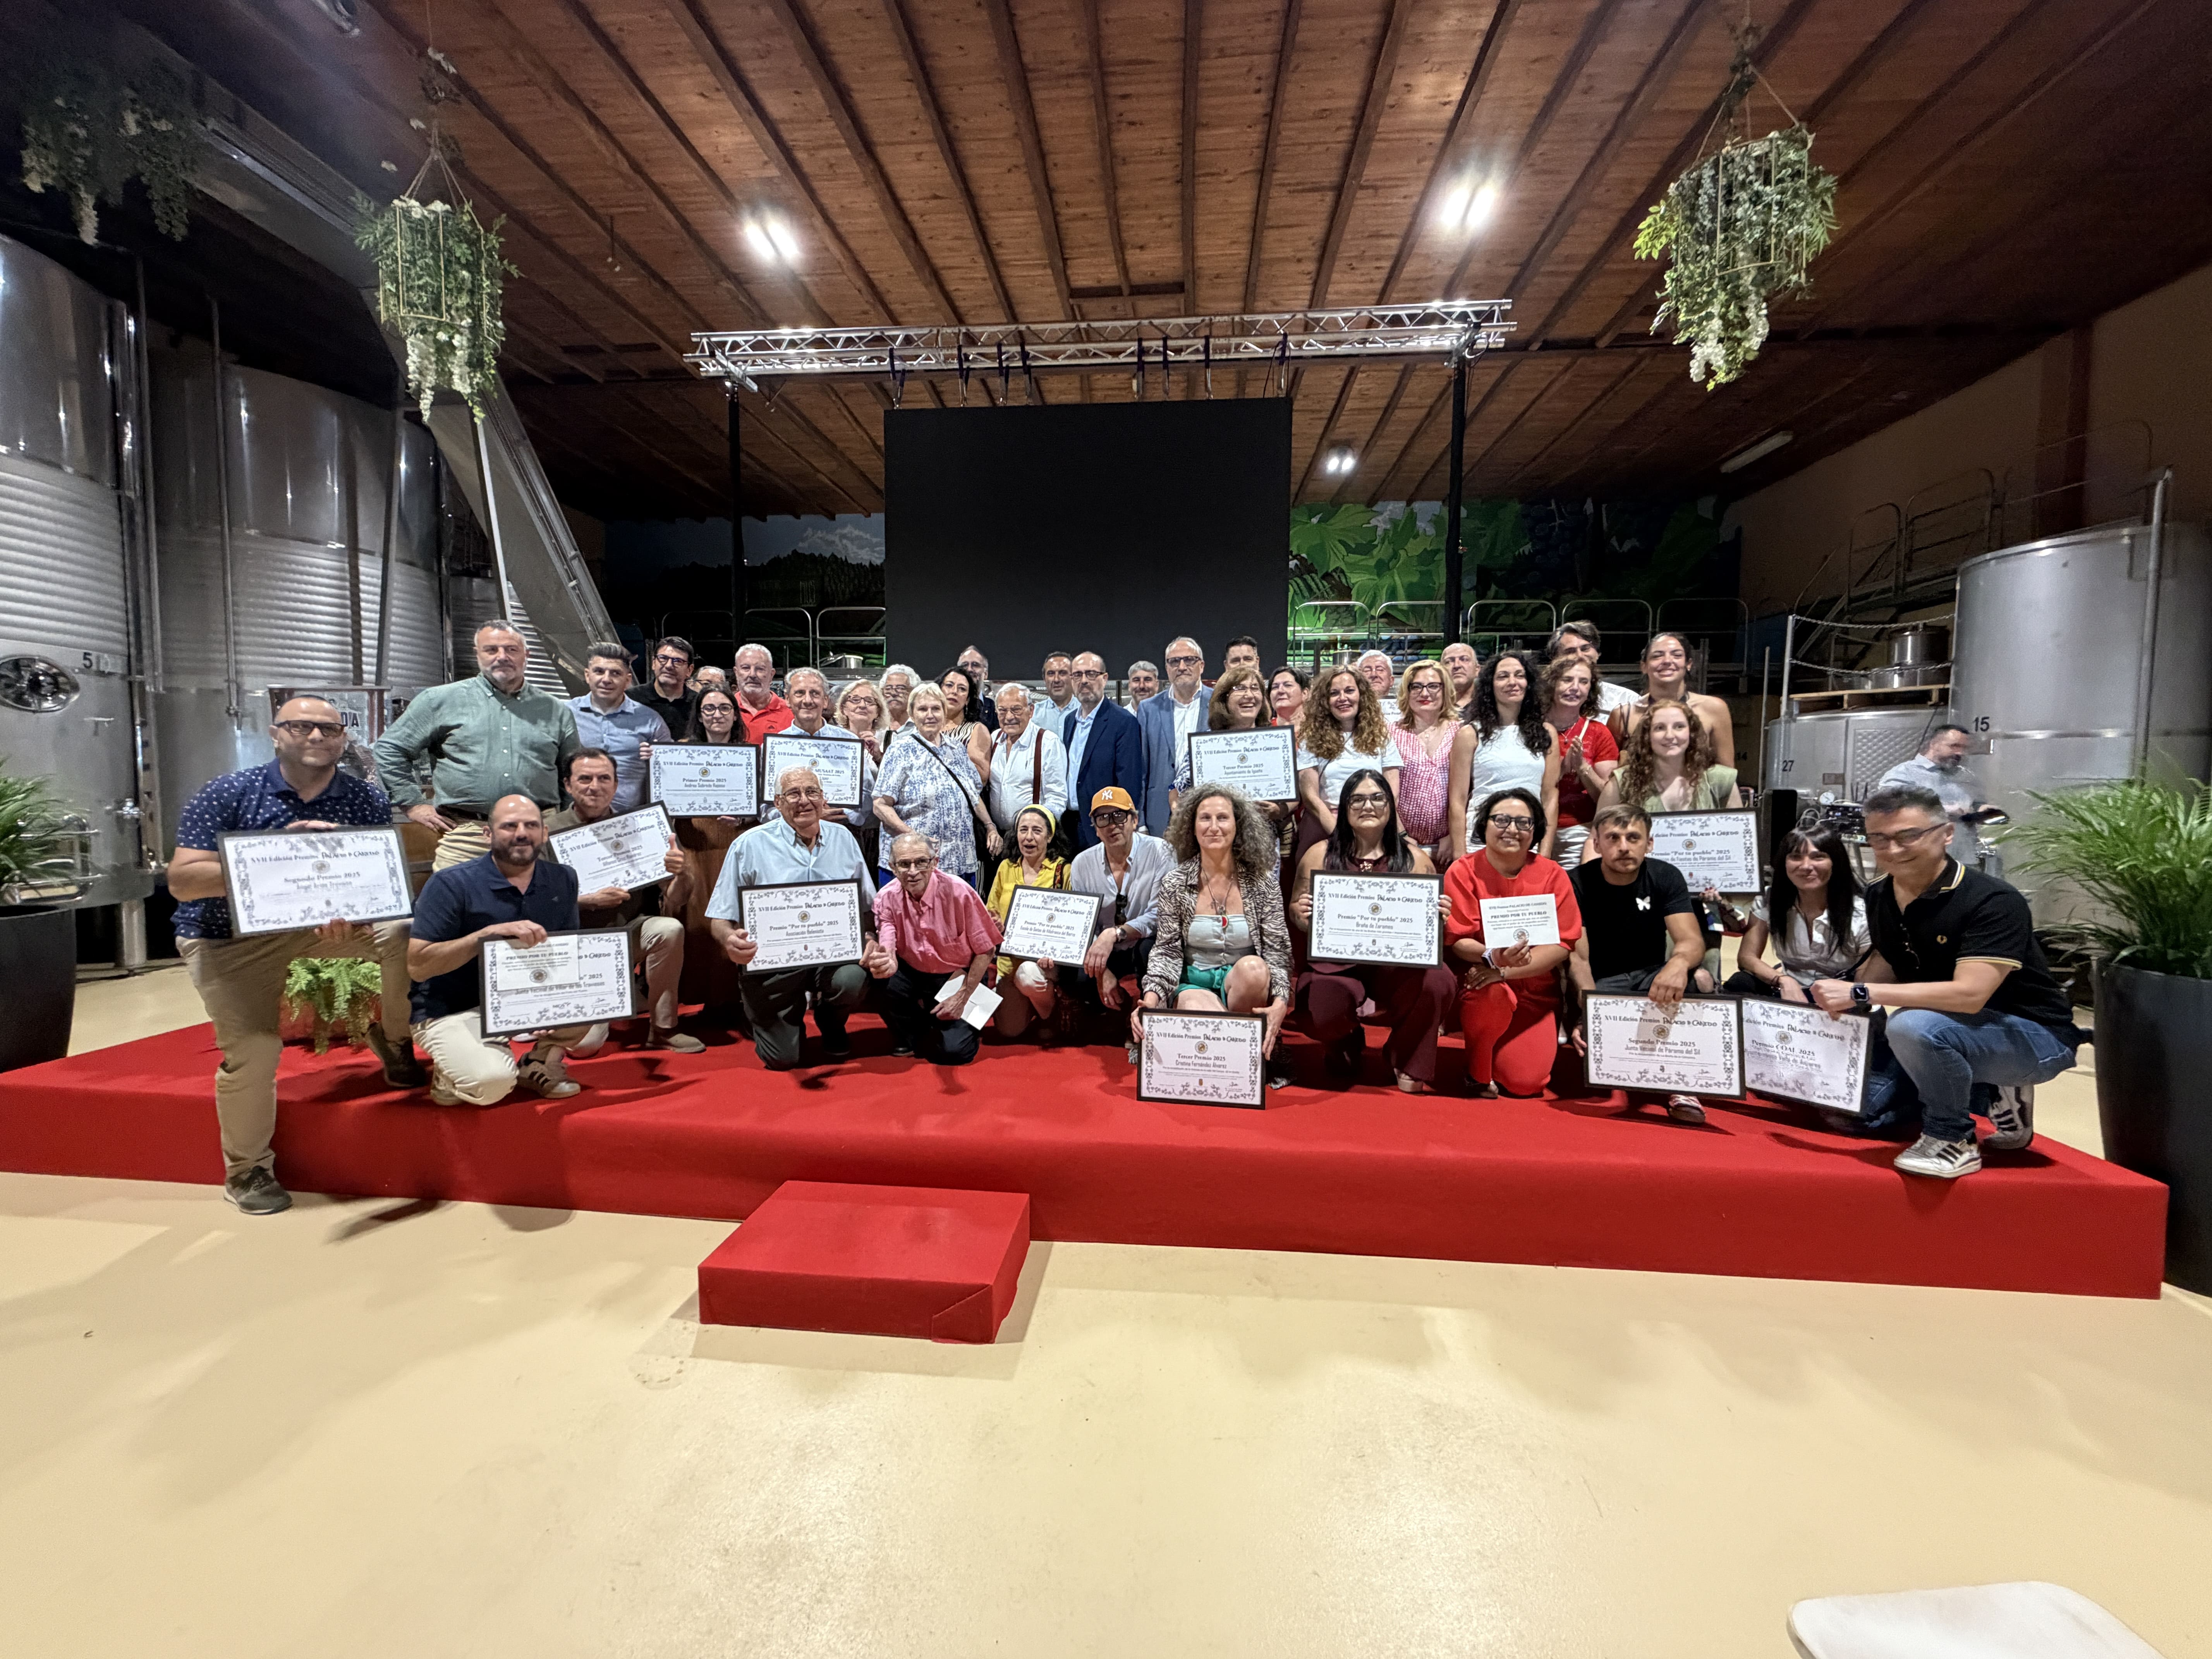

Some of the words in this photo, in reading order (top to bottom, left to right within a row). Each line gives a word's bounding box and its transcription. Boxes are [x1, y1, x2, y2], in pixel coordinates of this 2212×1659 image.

[82, 652, 93, 669] 5
[1973, 716, 1990, 732] 15
[1782, 760, 1794, 772] 27
[1102, 789, 1113, 800] NY
[1752, 1040, 1774, 1048] Premio
